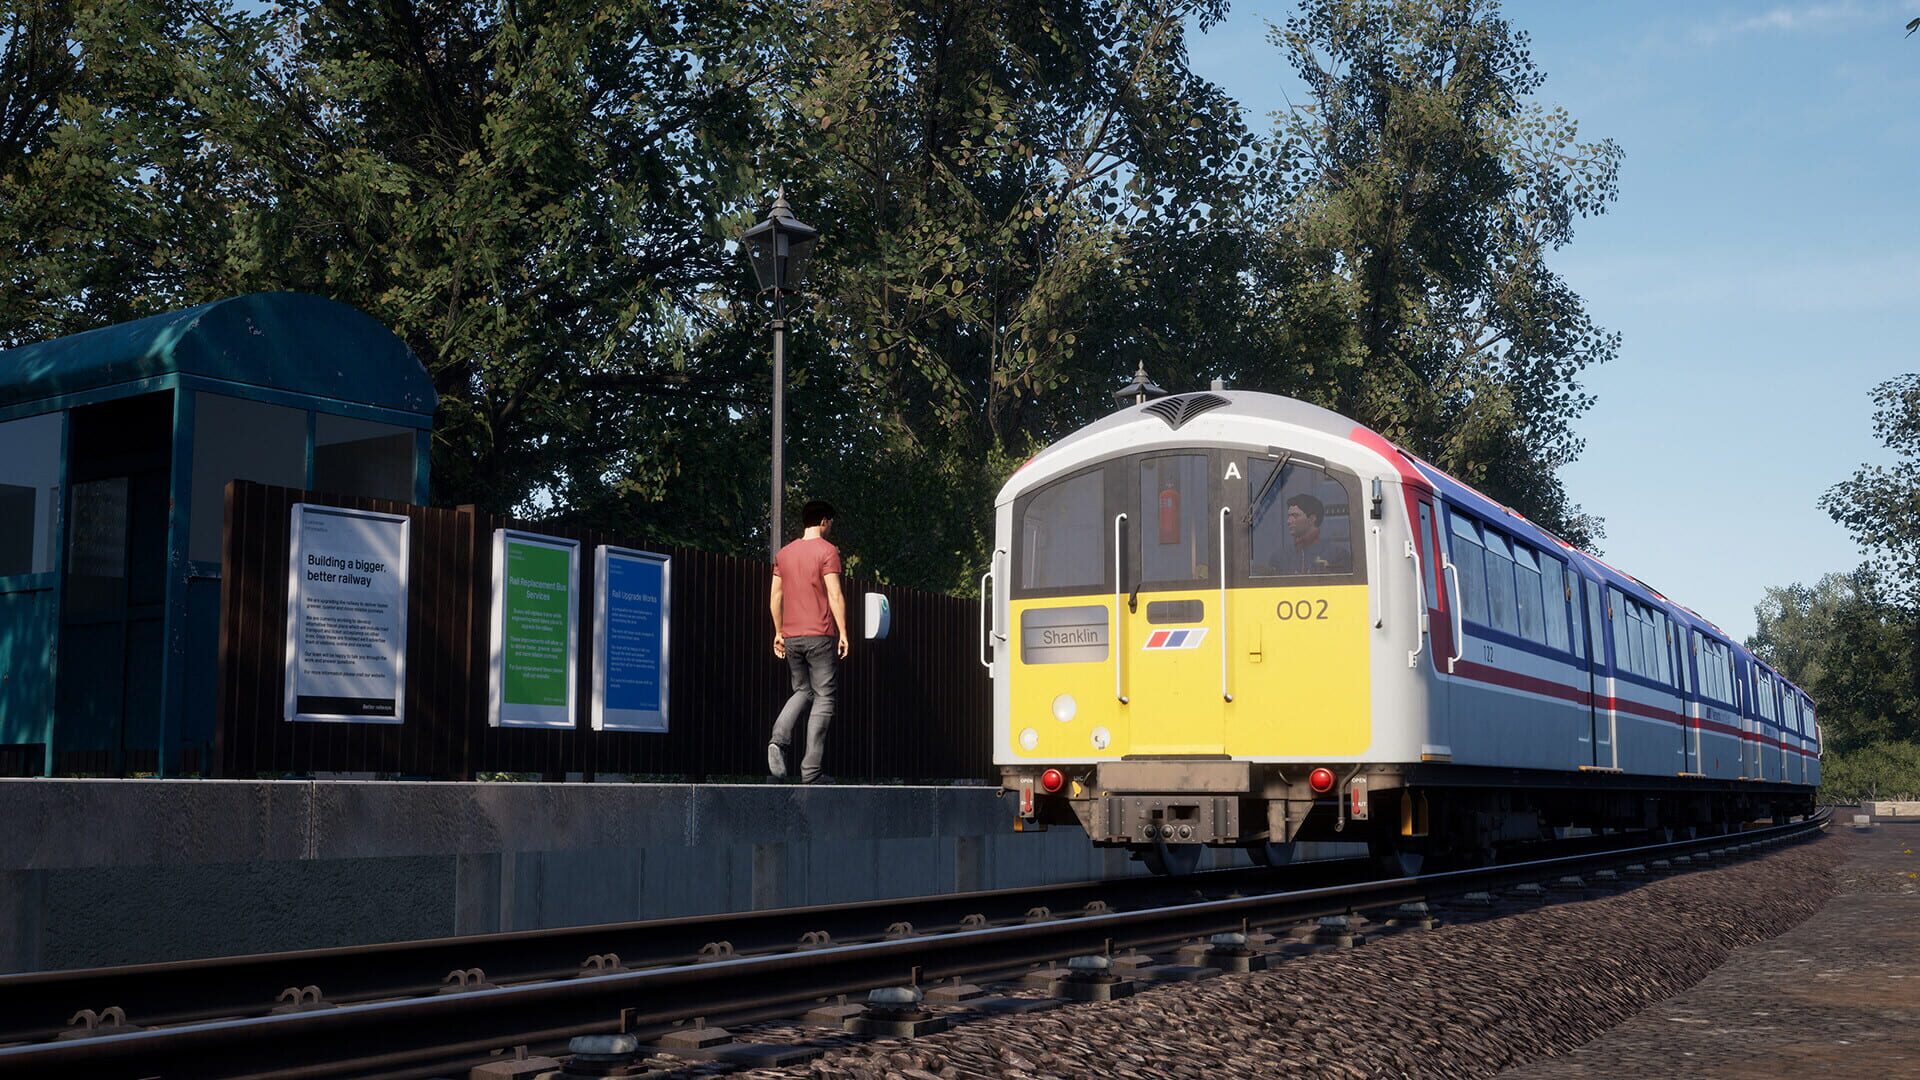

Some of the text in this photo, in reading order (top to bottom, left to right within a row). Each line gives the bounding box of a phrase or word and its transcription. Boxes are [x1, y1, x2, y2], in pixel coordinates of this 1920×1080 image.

[1224, 462, 1241, 480] A
[308, 554, 346, 570] Building
[348, 560, 354, 569] a
[307, 570, 372, 588] better railway
[510, 576, 566, 592] Rail Replacement Bus
[526, 590, 550, 600] Services
[1043, 629, 1098, 644] Shanklin
[1483, 645, 1494, 663] 122
